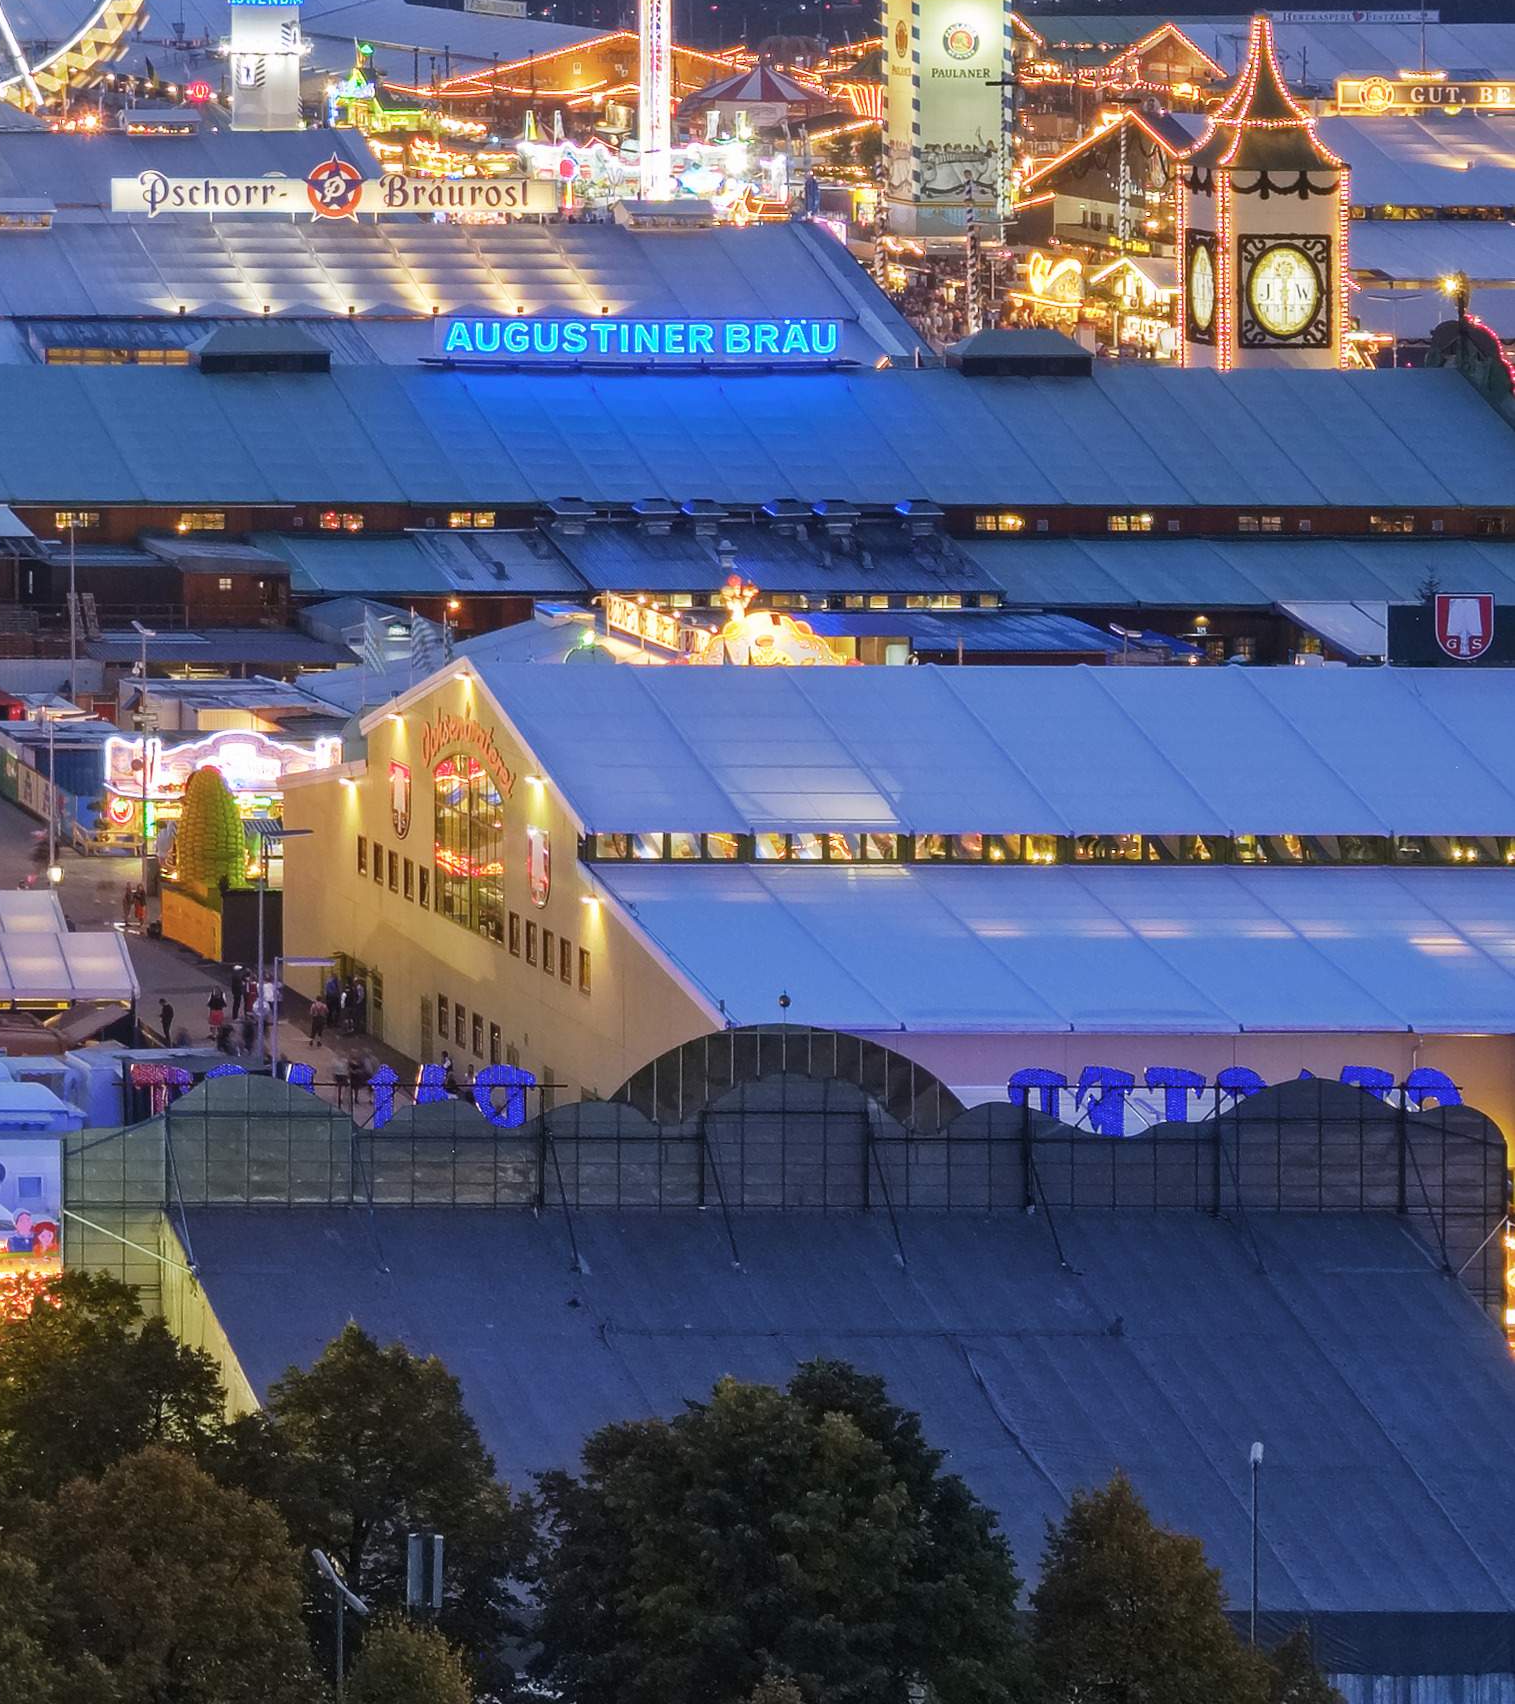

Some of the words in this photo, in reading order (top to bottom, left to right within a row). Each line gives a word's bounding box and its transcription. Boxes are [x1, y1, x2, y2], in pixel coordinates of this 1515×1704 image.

[931, 67, 991, 79] PAULANER
[1410, 86, 1466, 104] GUT,
[379, 174, 530, 208] Bräurosl
[445, 322, 715, 354] AUGUSTINER
[725, 318, 838, 354] BRÄU
[1446, 638, 1458, 649] G
[1471, 638, 1482, 649] S
